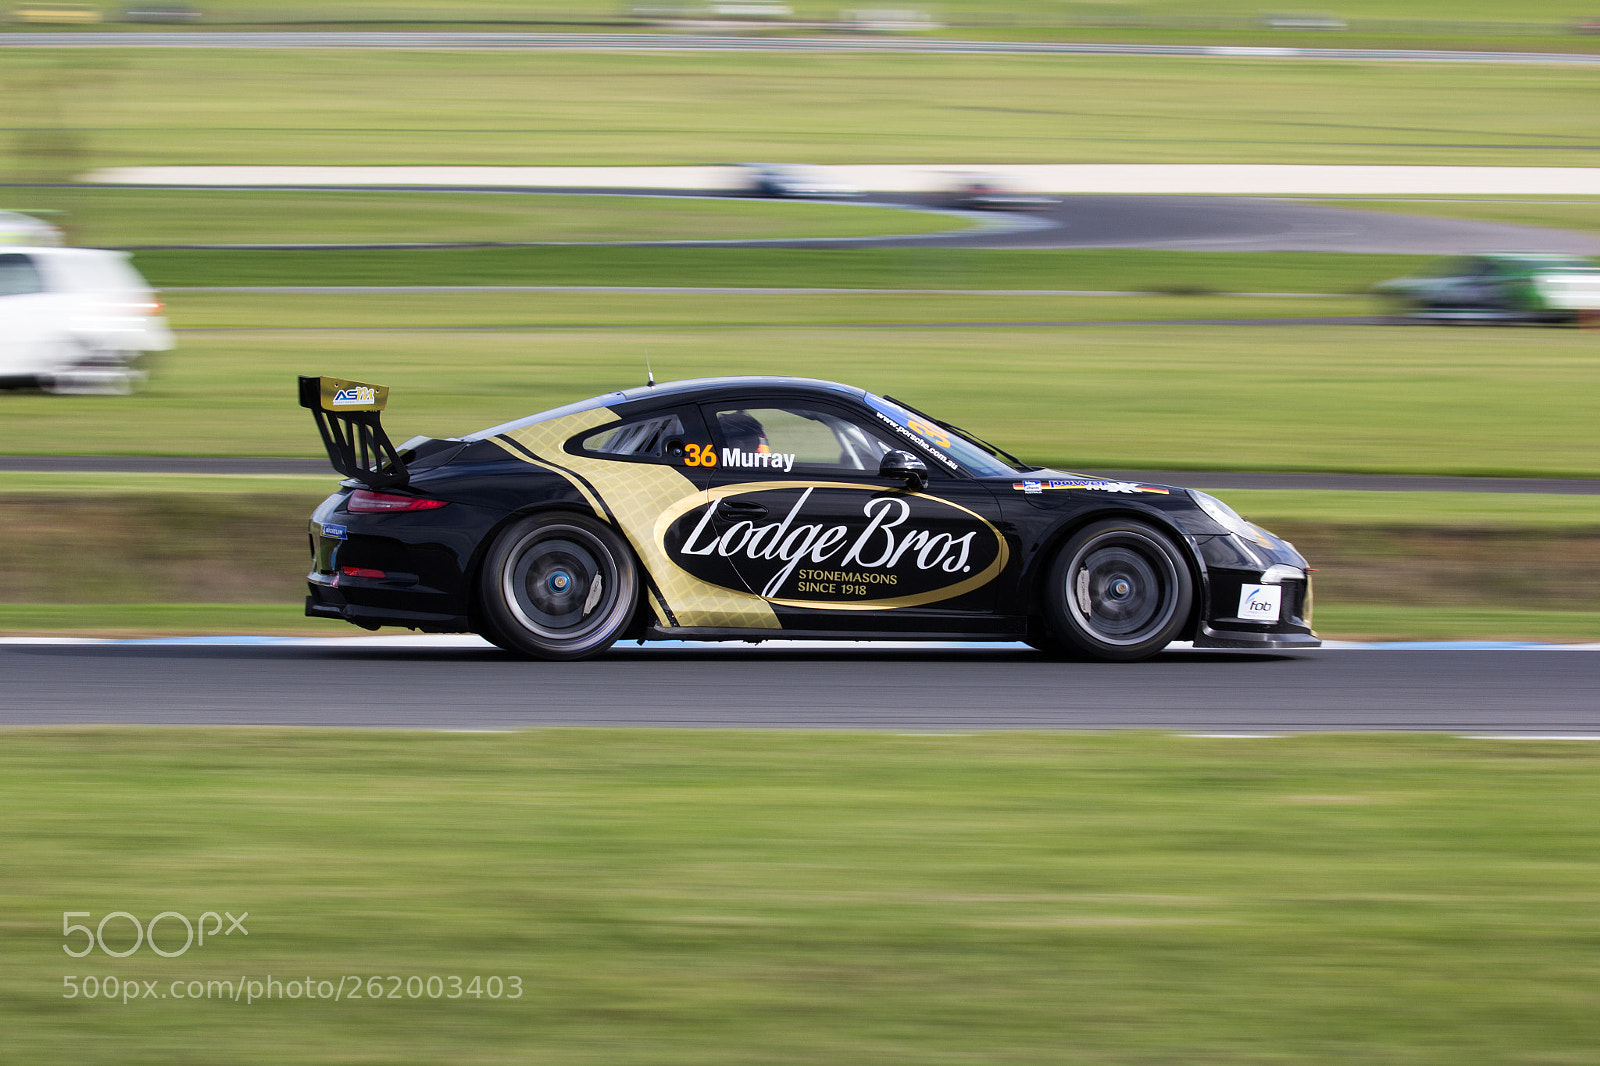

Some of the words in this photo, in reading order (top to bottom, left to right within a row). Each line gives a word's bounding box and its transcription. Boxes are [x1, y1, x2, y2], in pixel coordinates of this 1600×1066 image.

[876, 411, 958, 470] www.porsche.com.au
[684, 443, 717, 467] 36
[722, 447, 796, 473] Murray
[681, 486, 848, 599] Lodge
[841, 497, 977, 574] Bros.
[797, 581, 837, 594] SINCE
[841, 584, 867, 596] 1918
[798, 568, 898, 586] STONEMASONS
